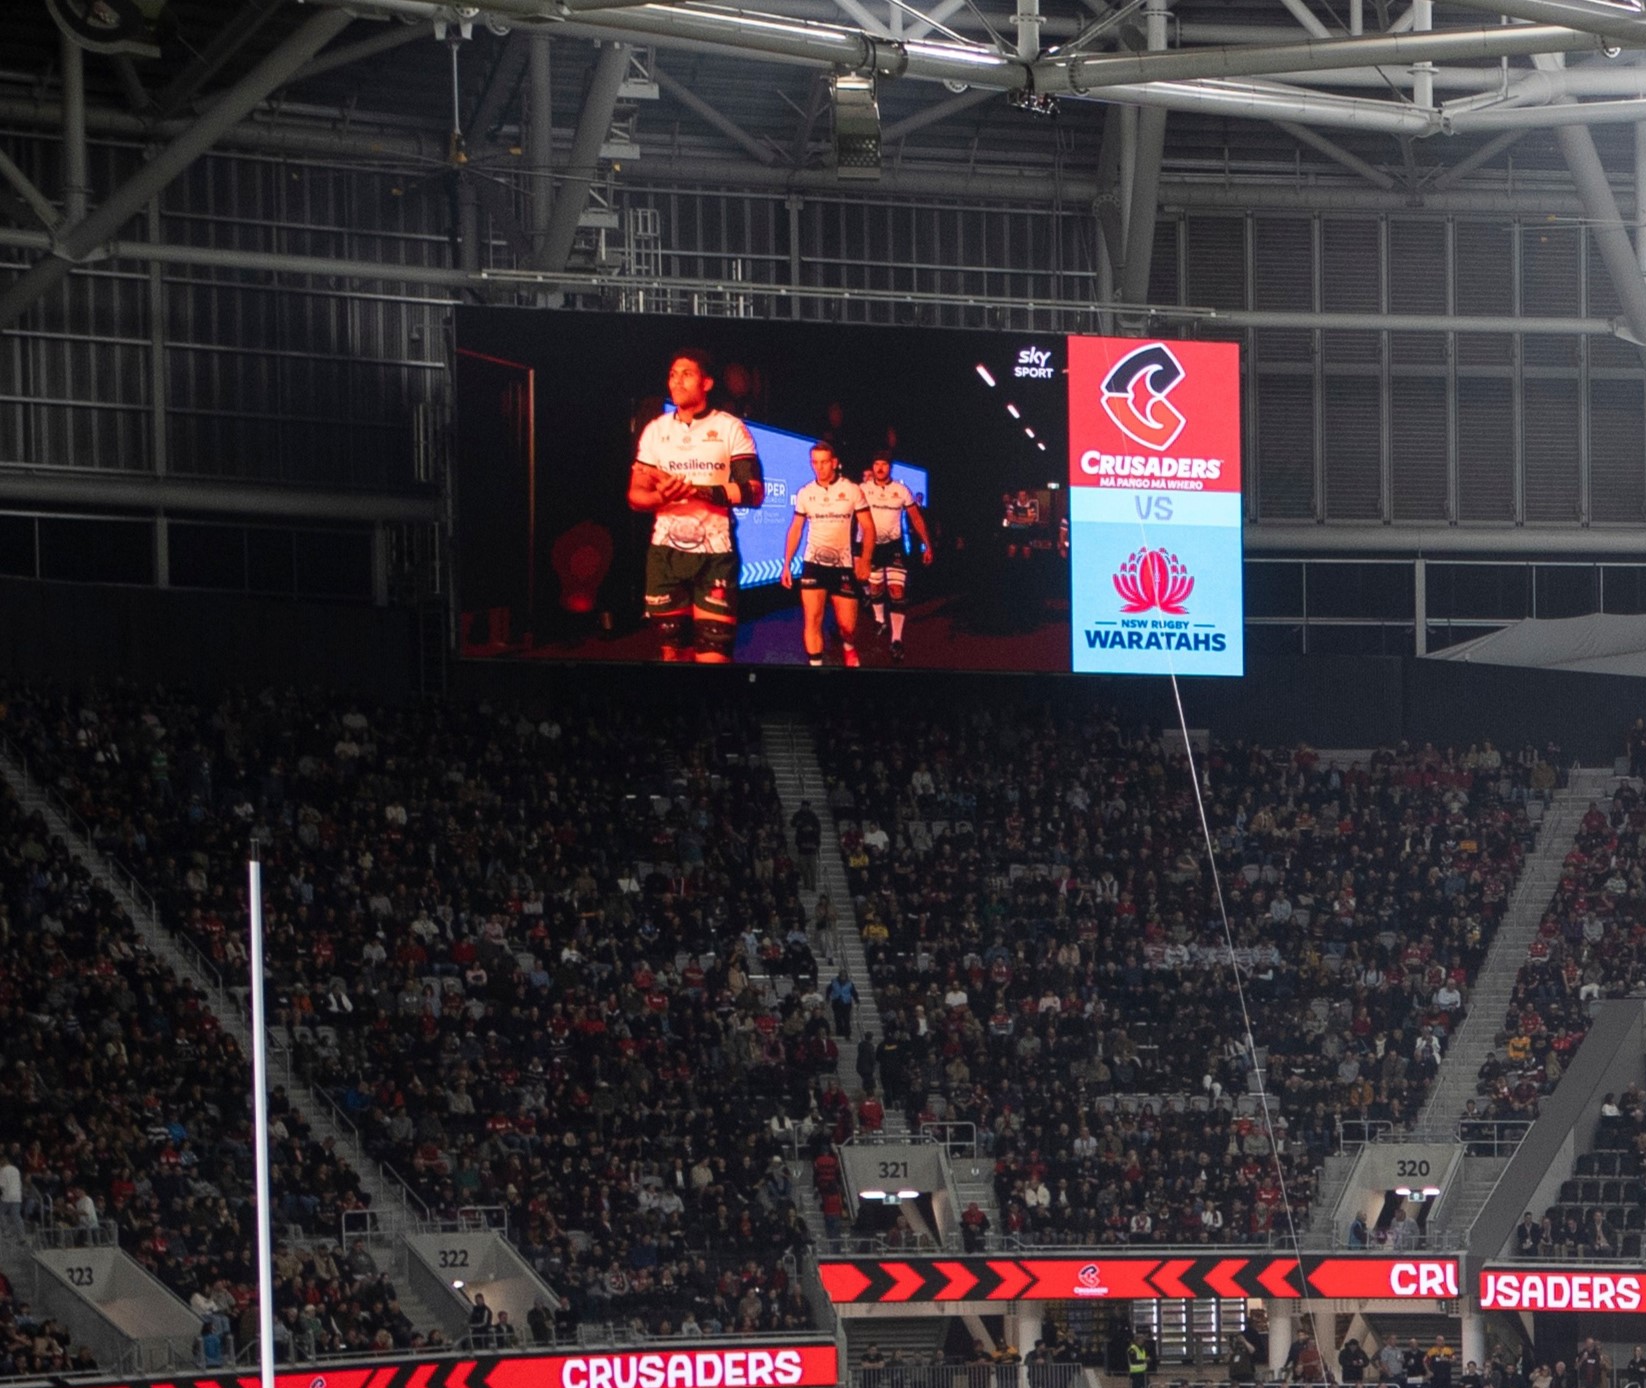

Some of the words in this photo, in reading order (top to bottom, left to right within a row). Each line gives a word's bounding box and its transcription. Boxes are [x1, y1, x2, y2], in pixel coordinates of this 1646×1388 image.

[1018, 347, 1051, 368] sky
[1014, 367, 1054, 378] SPORT
[668, 459, 726, 471] Resilience
[1081, 450, 1221, 479] CRUSADERS
[763, 482, 786, 496] PER
[1117, 478, 1149, 488] PANGO
[1168, 480, 1203, 490] WHERO
[1135, 494, 1174, 521] VS
[1121, 619, 1149, 629] NSW
[1151, 620, 1190, 629] RUGBY
[1085, 630, 1227, 651] WARATAHS
[879, 1161, 908, 1178] 321
[1397, 1160, 1430, 1177] 320
[439, 1249, 469, 1268] 322
